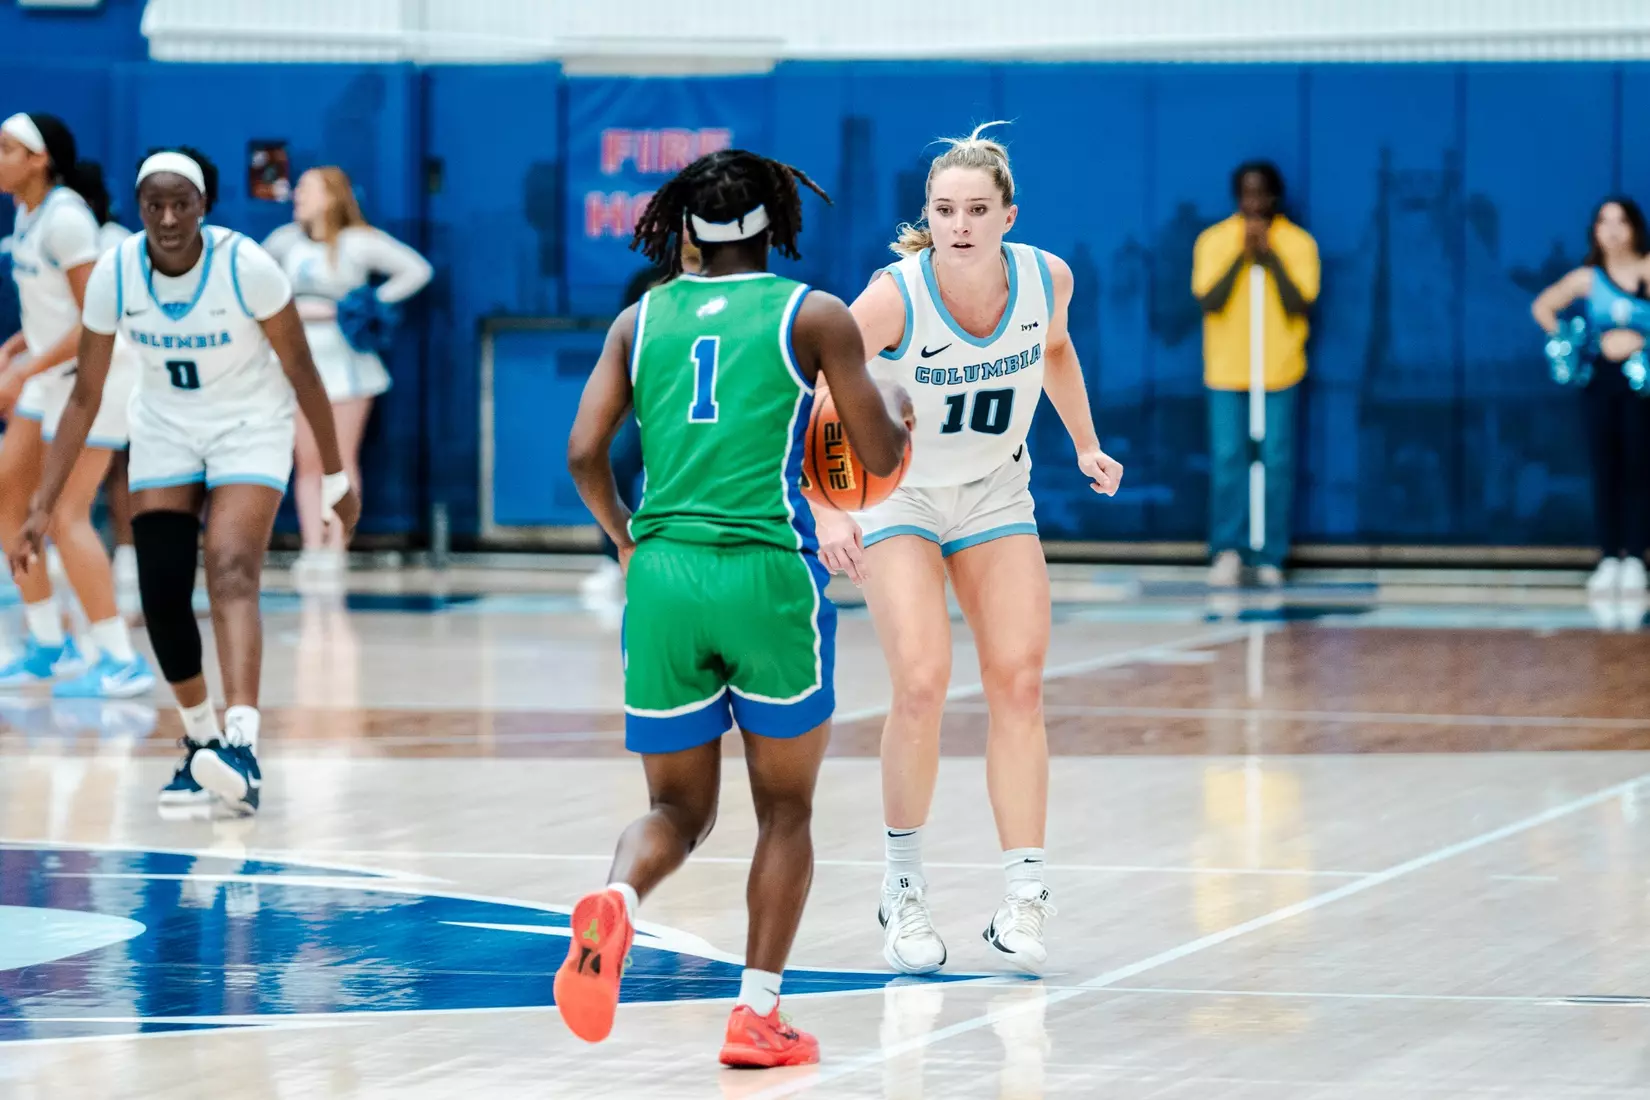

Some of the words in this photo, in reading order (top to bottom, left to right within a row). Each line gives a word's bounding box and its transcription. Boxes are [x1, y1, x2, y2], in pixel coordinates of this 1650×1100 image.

[165, 360, 200, 389] 0
[688, 335, 720, 423] 1
[915, 343, 1041, 385] COLUMBIA
[940, 386, 1016, 435] 10
